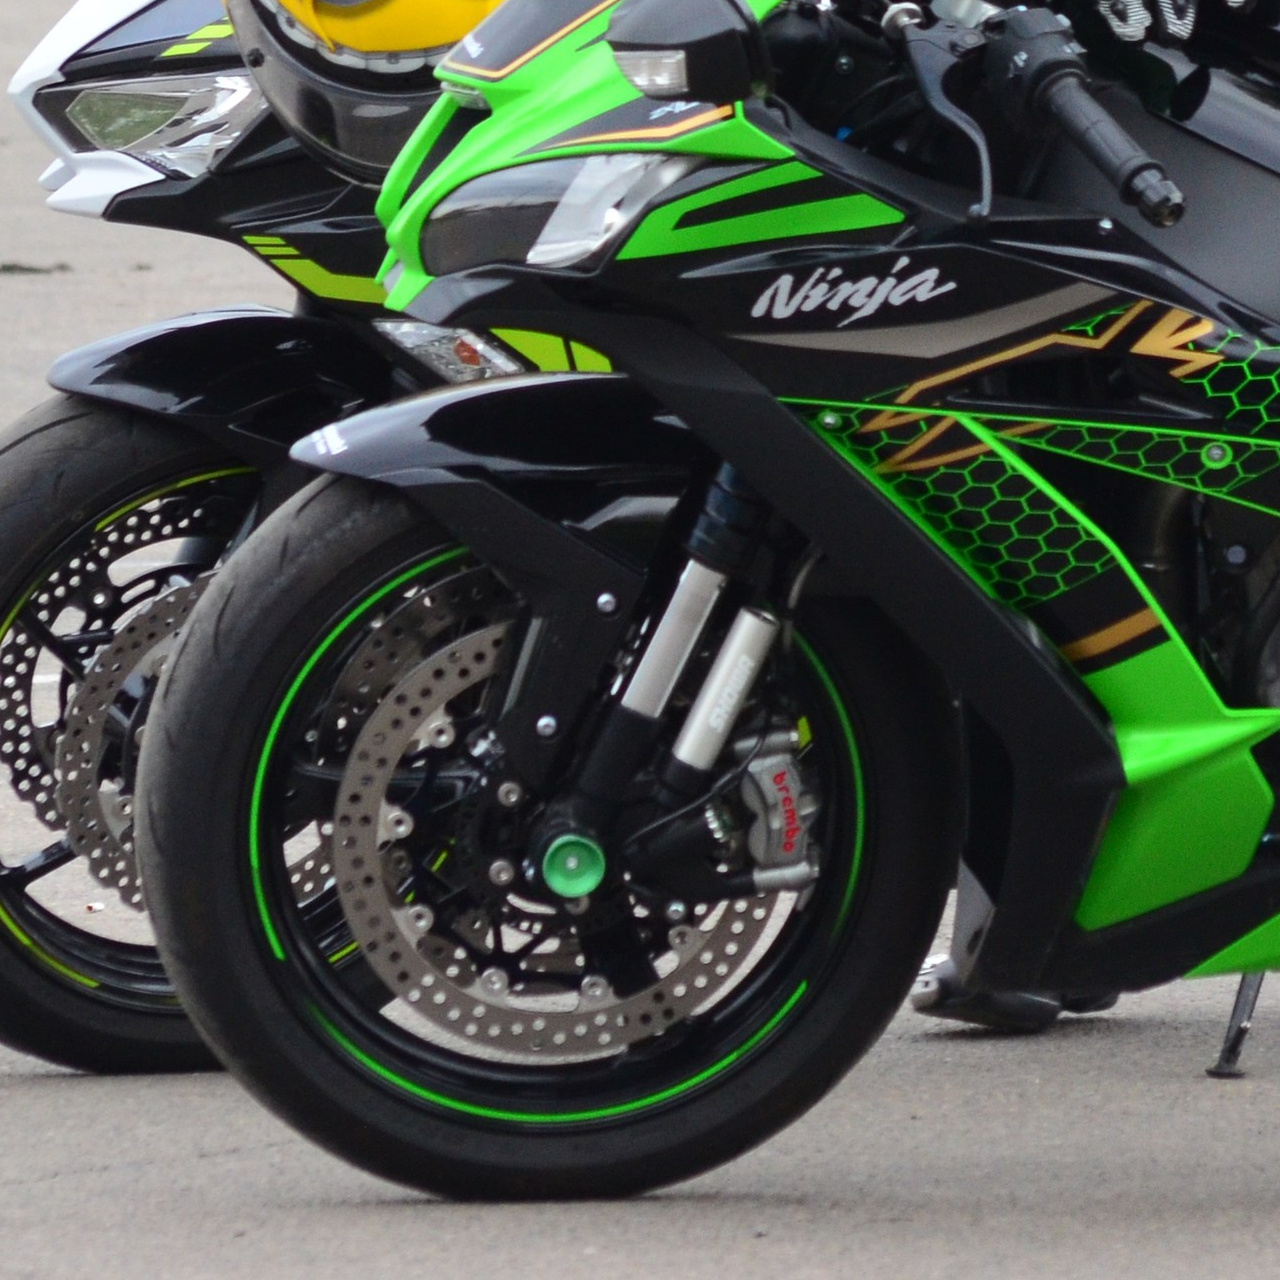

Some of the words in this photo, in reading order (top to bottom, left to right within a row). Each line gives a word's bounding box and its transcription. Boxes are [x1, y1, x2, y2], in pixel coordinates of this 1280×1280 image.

[751, 255, 958, 329] Ninja
[708, 654, 755, 732] SHOWA
[773, 770, 801, 854] brembo
